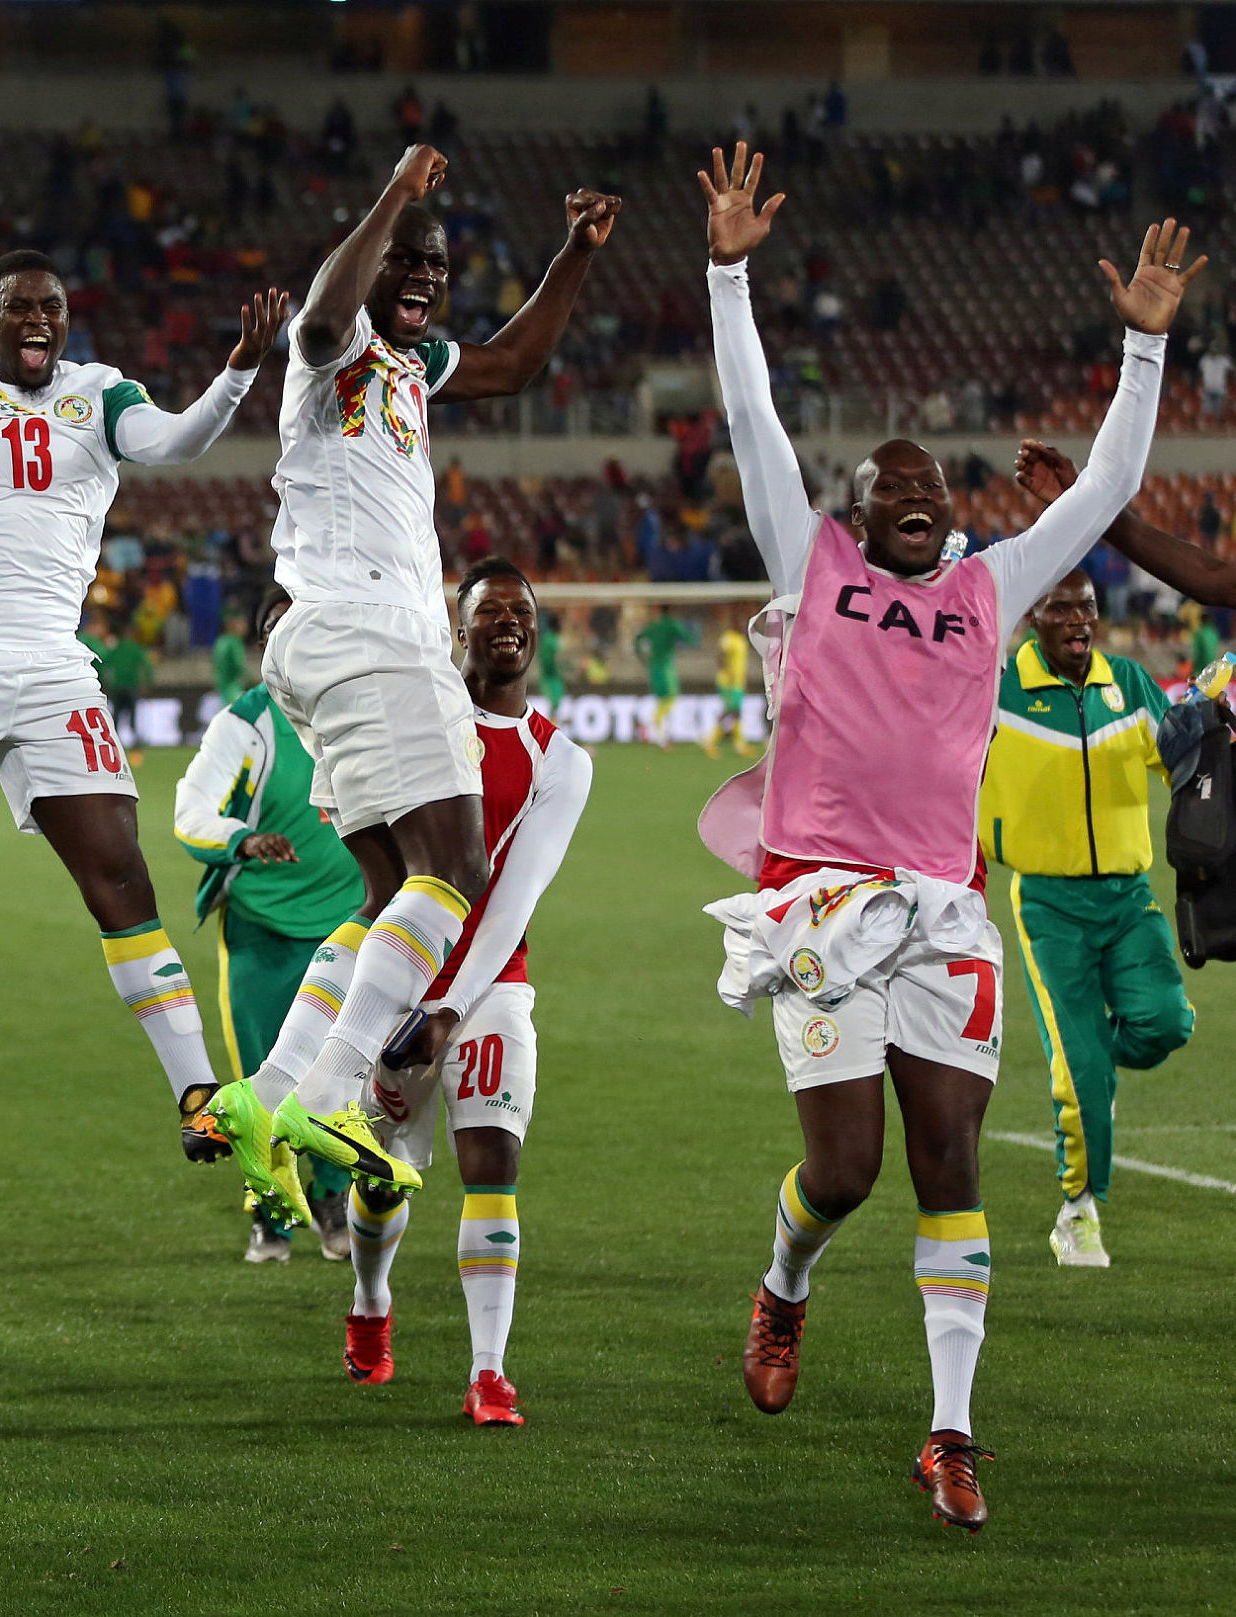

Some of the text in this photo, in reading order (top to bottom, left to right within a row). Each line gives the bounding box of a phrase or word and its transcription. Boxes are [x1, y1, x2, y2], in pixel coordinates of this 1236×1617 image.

[2, 417, 53, 492] 13
[66, 707, 122, 773] 13
[946, 959, 997, 1042] 7
[457, 1033, 504, 1101] 20
[485, 1098, 521, 1113] romai
